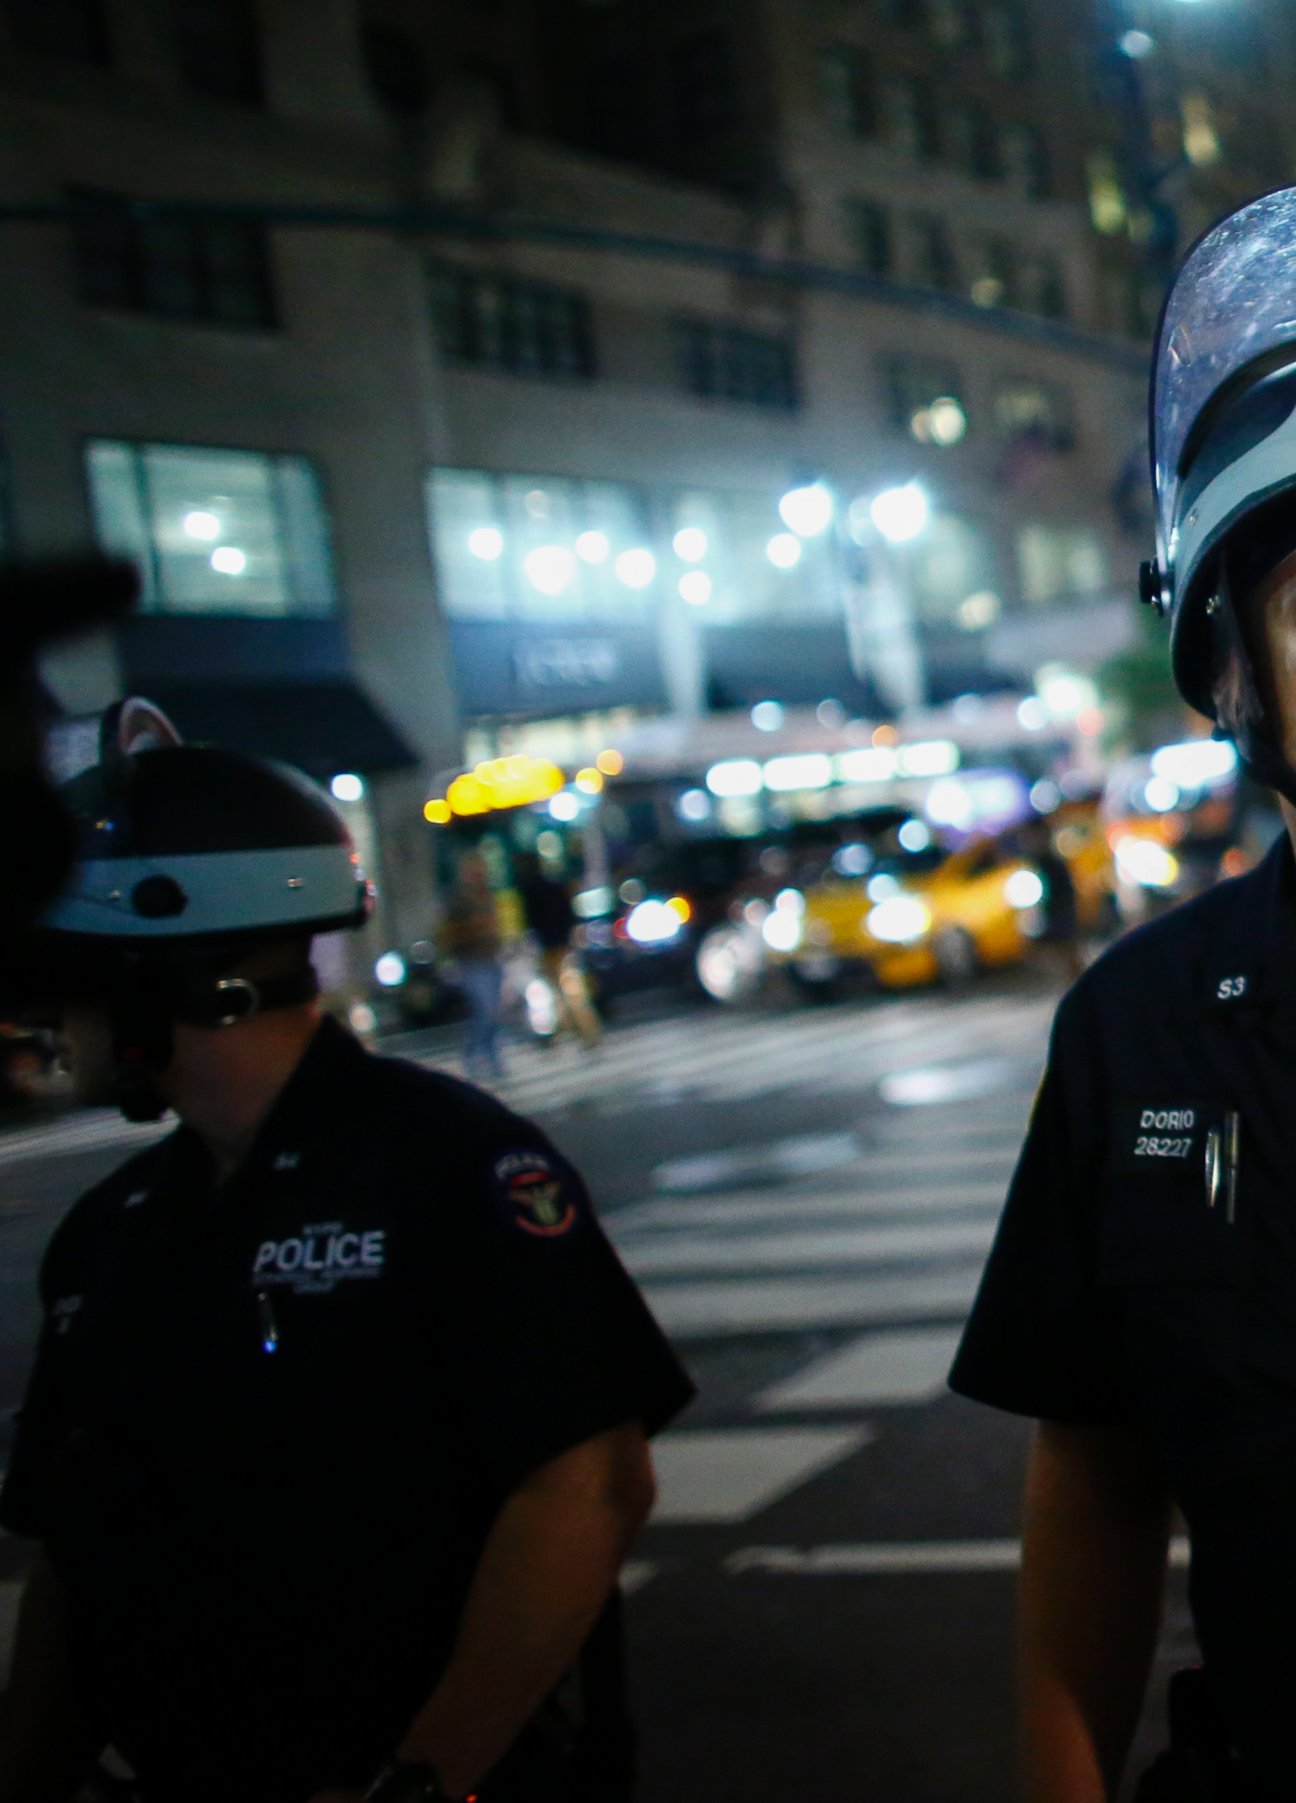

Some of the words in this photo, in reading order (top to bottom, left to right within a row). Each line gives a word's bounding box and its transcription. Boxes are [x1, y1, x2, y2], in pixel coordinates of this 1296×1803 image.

[1217, 976, 1246, 1000] S3
[1140, 1109, 1195, 1130] DORIO
[1134, 1136, 1192, 1158] 28227
[253, 1230, 384, 1274] POLICE
